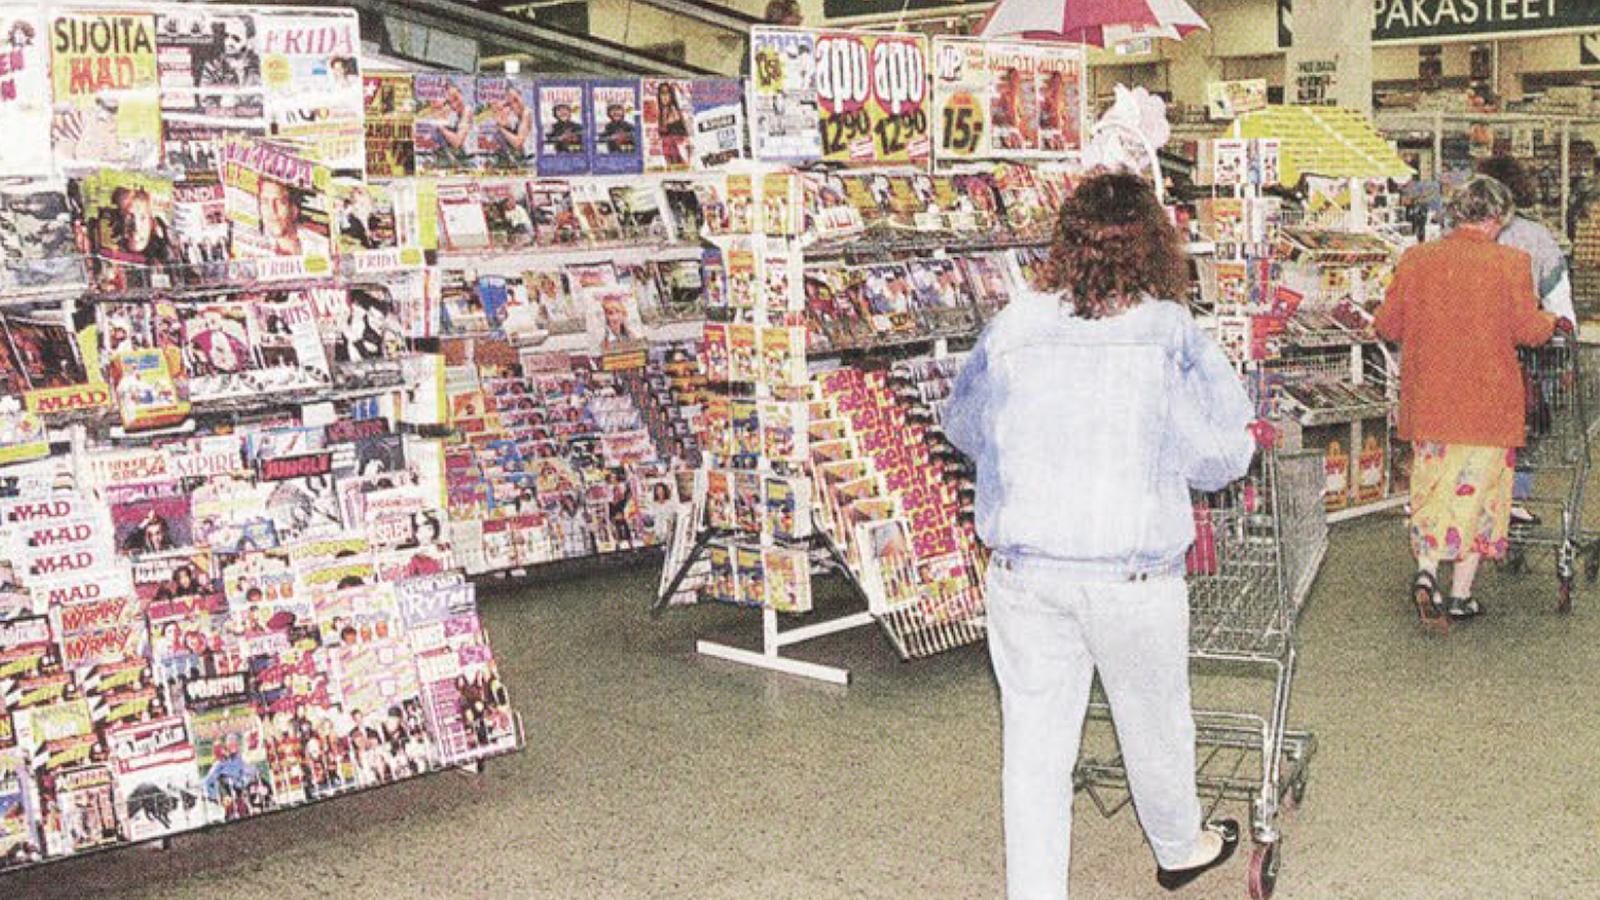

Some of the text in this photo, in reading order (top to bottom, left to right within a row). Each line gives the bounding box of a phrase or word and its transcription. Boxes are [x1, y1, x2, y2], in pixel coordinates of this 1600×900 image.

[1371, 0, 1554, 29] PAKASTEET
[54, 16, 153, 54] SIJOITA
[70, 56, 136, 95] MAD
[817, 38, 869, 113] apu
[874, 41, 926, 114] apu
[36, 391, 107, 411] MAD
[264, 455, 331, 481] JUNGLE
[14, 501, 71, 519] MAD
[33, 524, 92, 546] MAD
[34, 552, 93, 575] MAD
[49, 583, 101, 605] MAD
